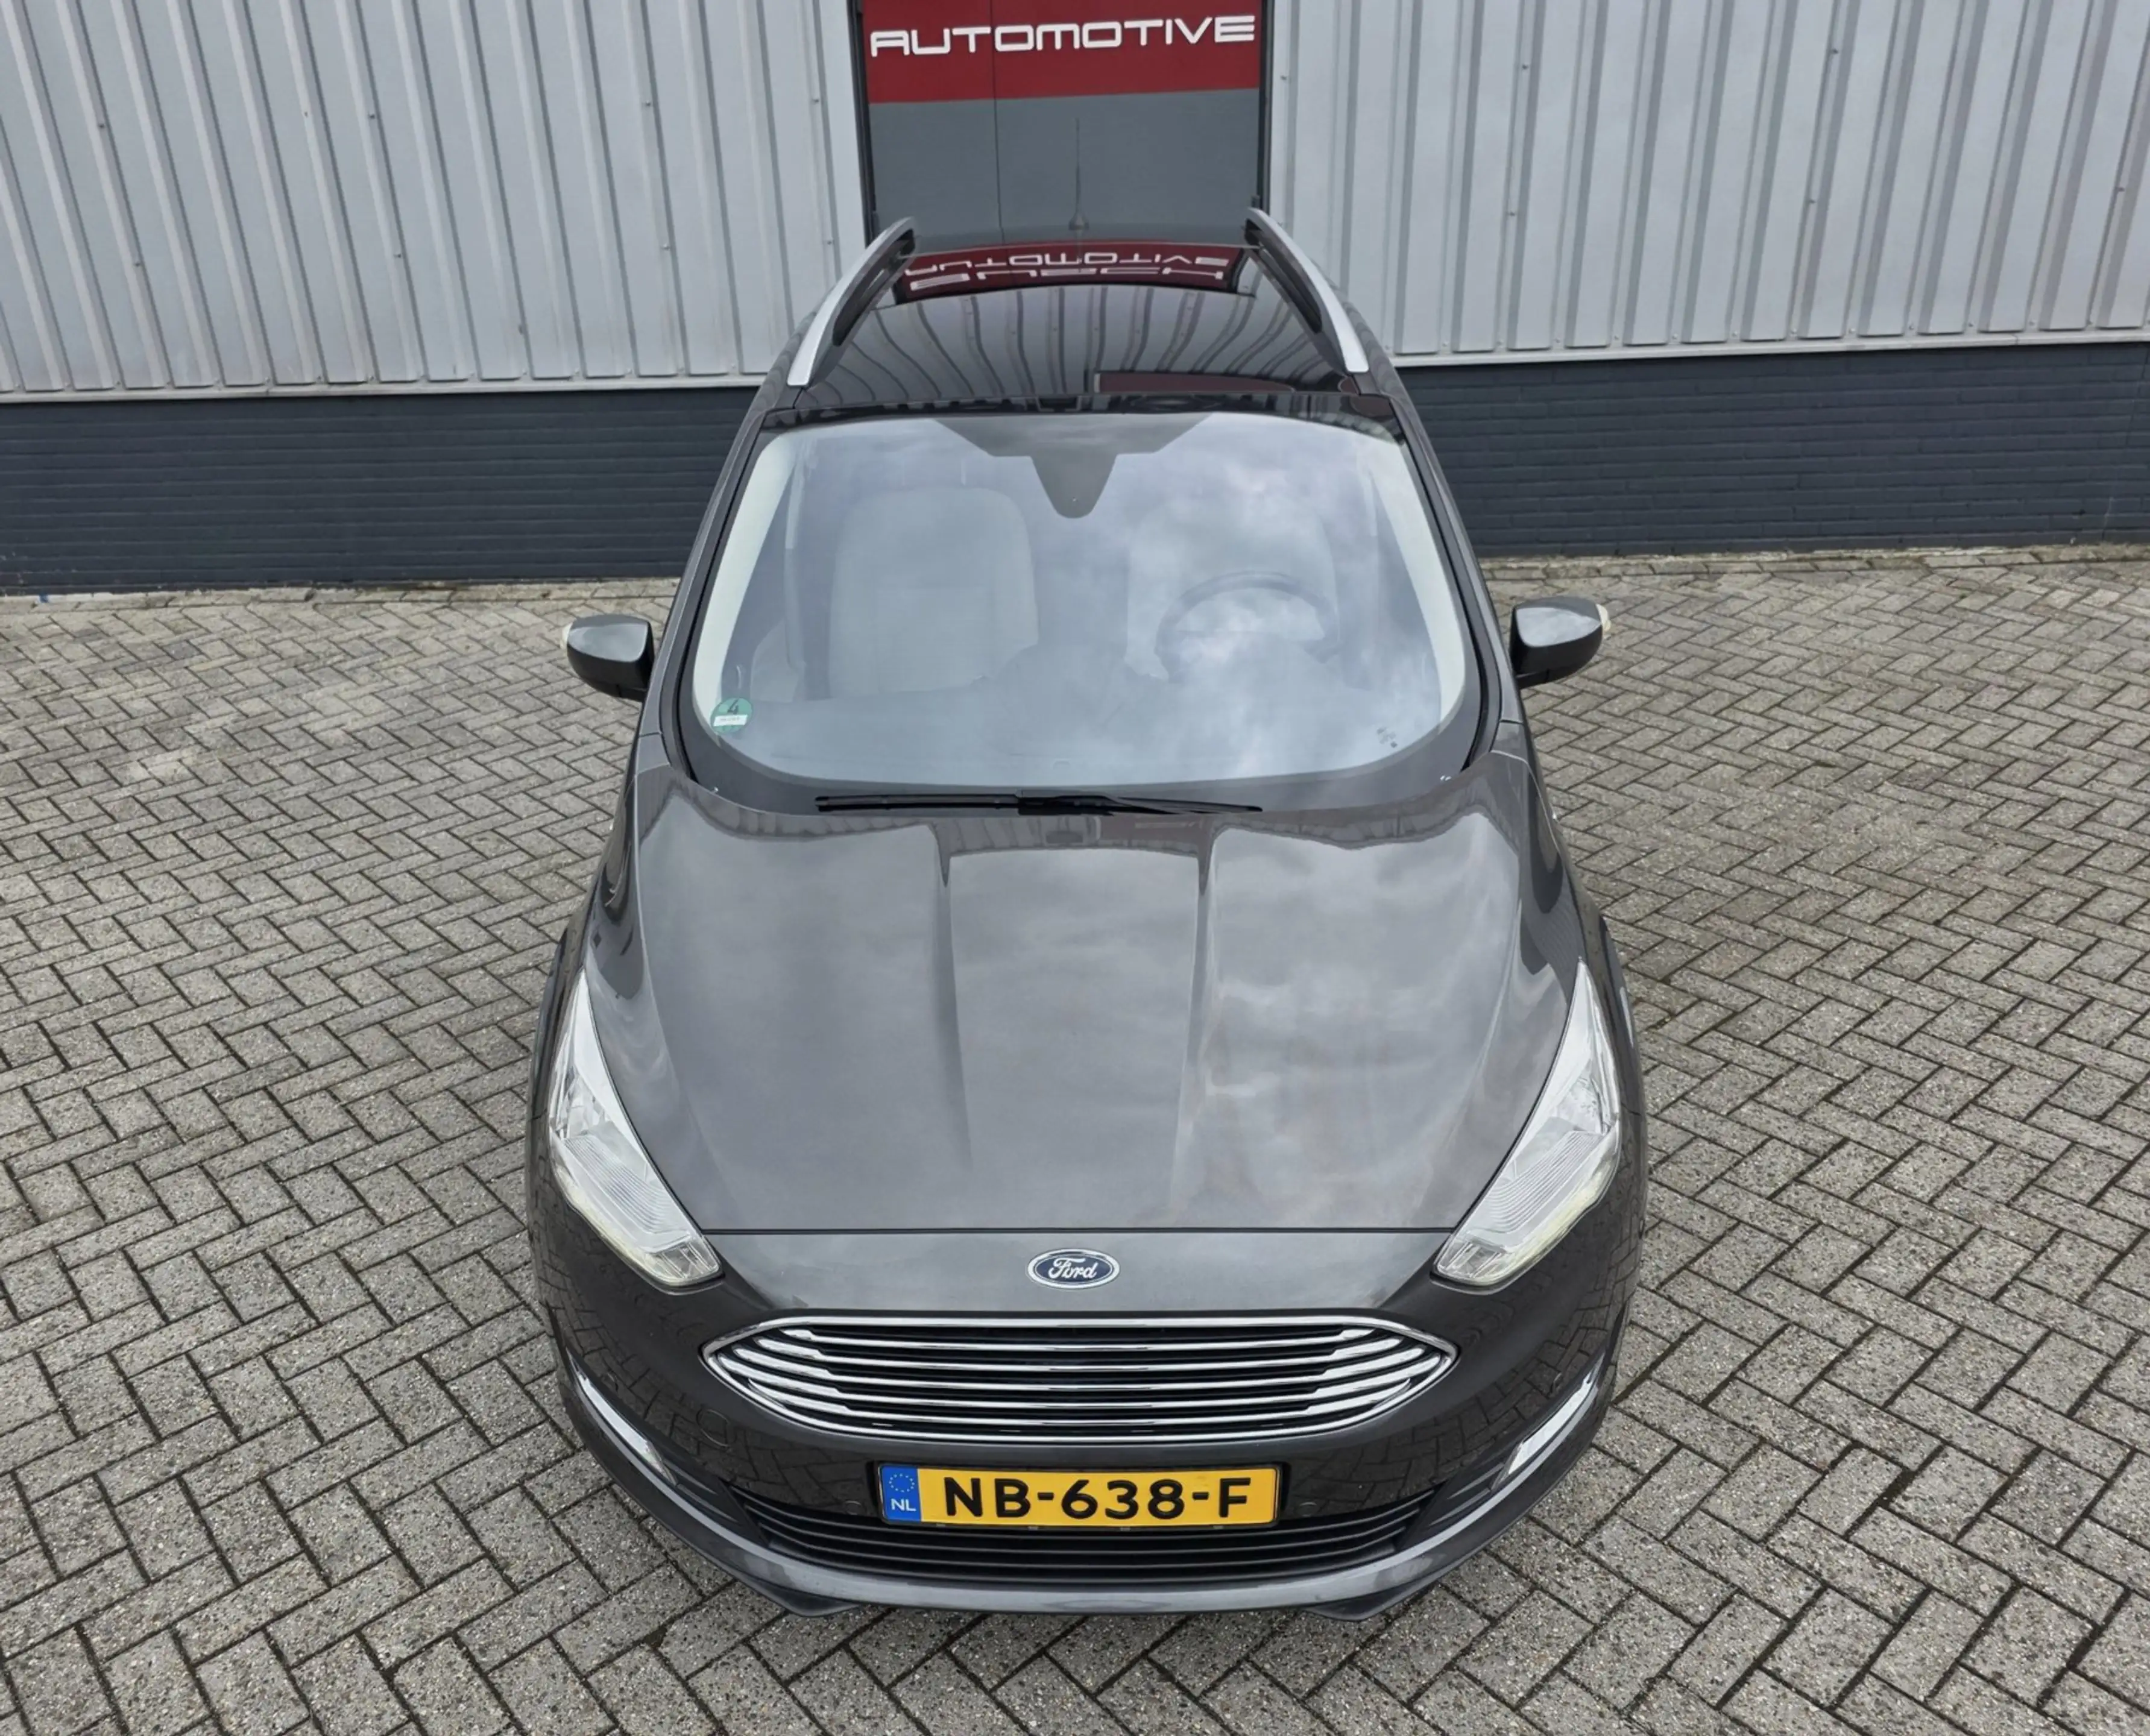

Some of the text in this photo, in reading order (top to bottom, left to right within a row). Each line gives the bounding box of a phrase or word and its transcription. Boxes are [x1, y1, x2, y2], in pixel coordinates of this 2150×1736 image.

[870, 15, 1256, 57] AUTOMOTIVE
[1047, 1257, 1099, 1279] Ford
[891, 1498, 917, 1512] NL
[944, 1477, 1252, 1520] NB-638-F
